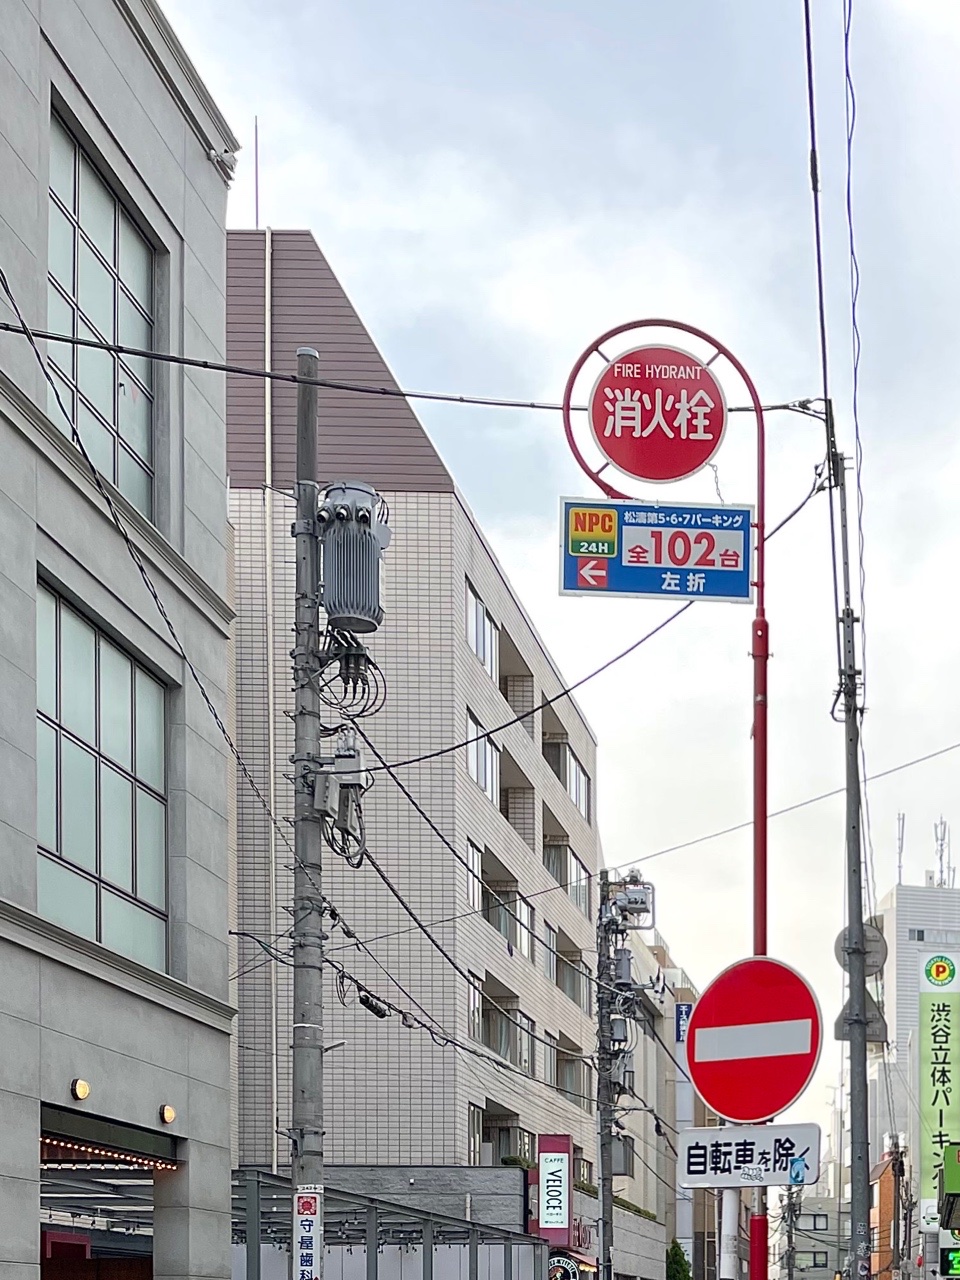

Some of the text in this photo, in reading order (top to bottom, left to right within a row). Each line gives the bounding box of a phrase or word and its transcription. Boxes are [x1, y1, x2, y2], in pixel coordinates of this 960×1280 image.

[613, 363, 702, 380] FIRE HYDRANT
[602, 387, 715, 440] 消火栓
[574, 512, 613, 533] NPC
[579, 541, 608, 554] 24H
[627, 530, 740, 568] 全102台
[661, 571, 706, 593] 左折
[687, 1137, 810, 1175] 自転車を除く
[546, 1169, 562, 1211] VELOCE
